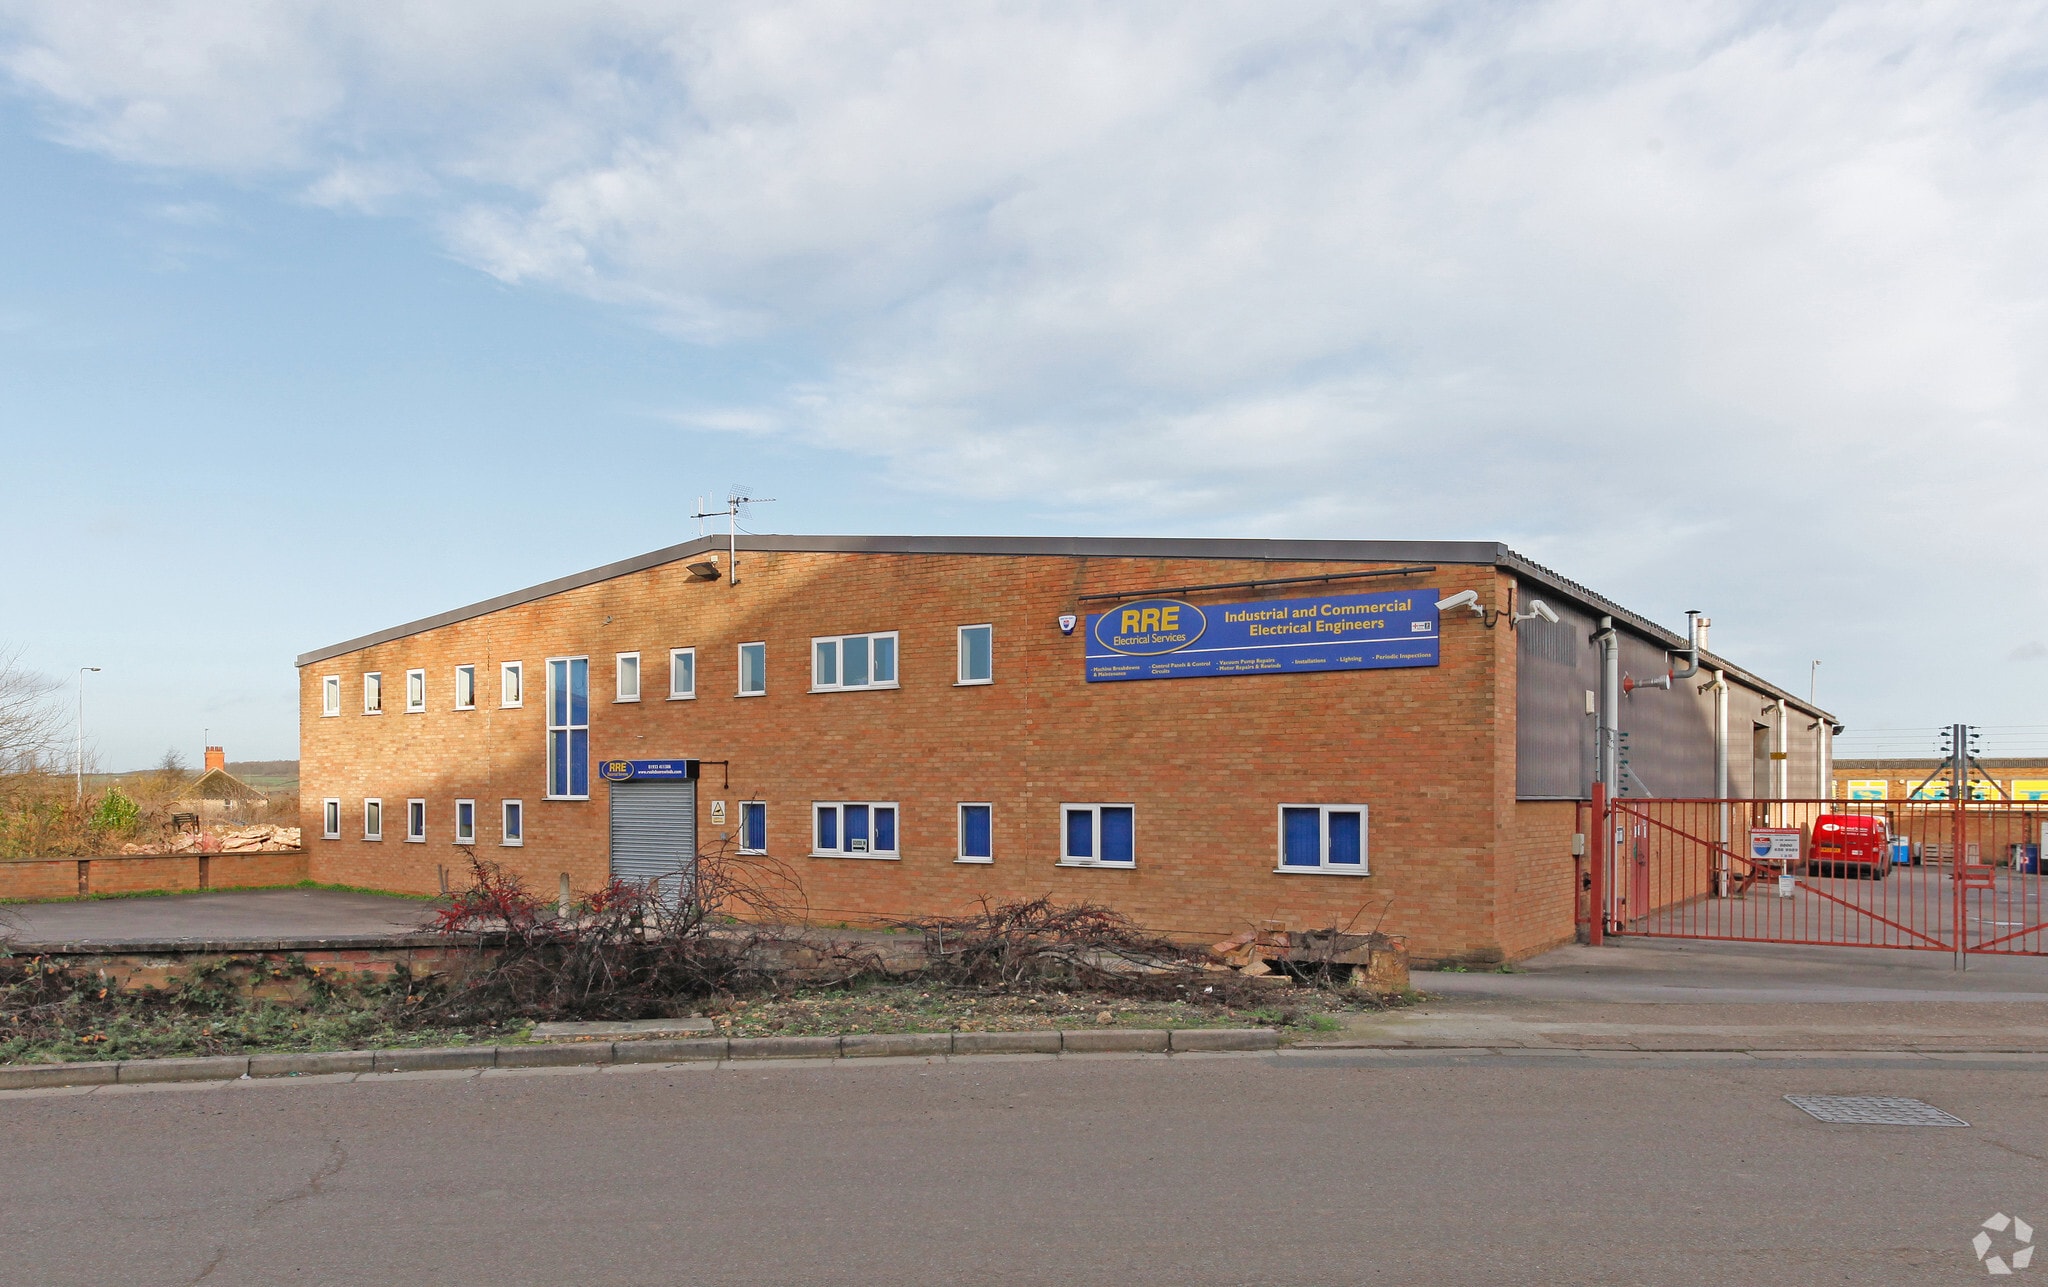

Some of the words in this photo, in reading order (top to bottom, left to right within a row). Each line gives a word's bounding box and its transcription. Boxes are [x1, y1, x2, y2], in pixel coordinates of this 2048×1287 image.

[1225, 607, 1288, 623] Industrial
[1292, 605, 1317, 618] and
[1320, 599, 1412, 616] Commercial
[1121, 606, 1180, 634] RRE
[1249, 621, 1312, 636] Electrical
[1316, 618, 1384, 634] Engineers
[1113, 634, 1150, 646] Electrical
[1151, 633, 1186, 643] Services
[1399, 652, 1431, 660] Inspections
[609, 762, 627, 772] RRE
